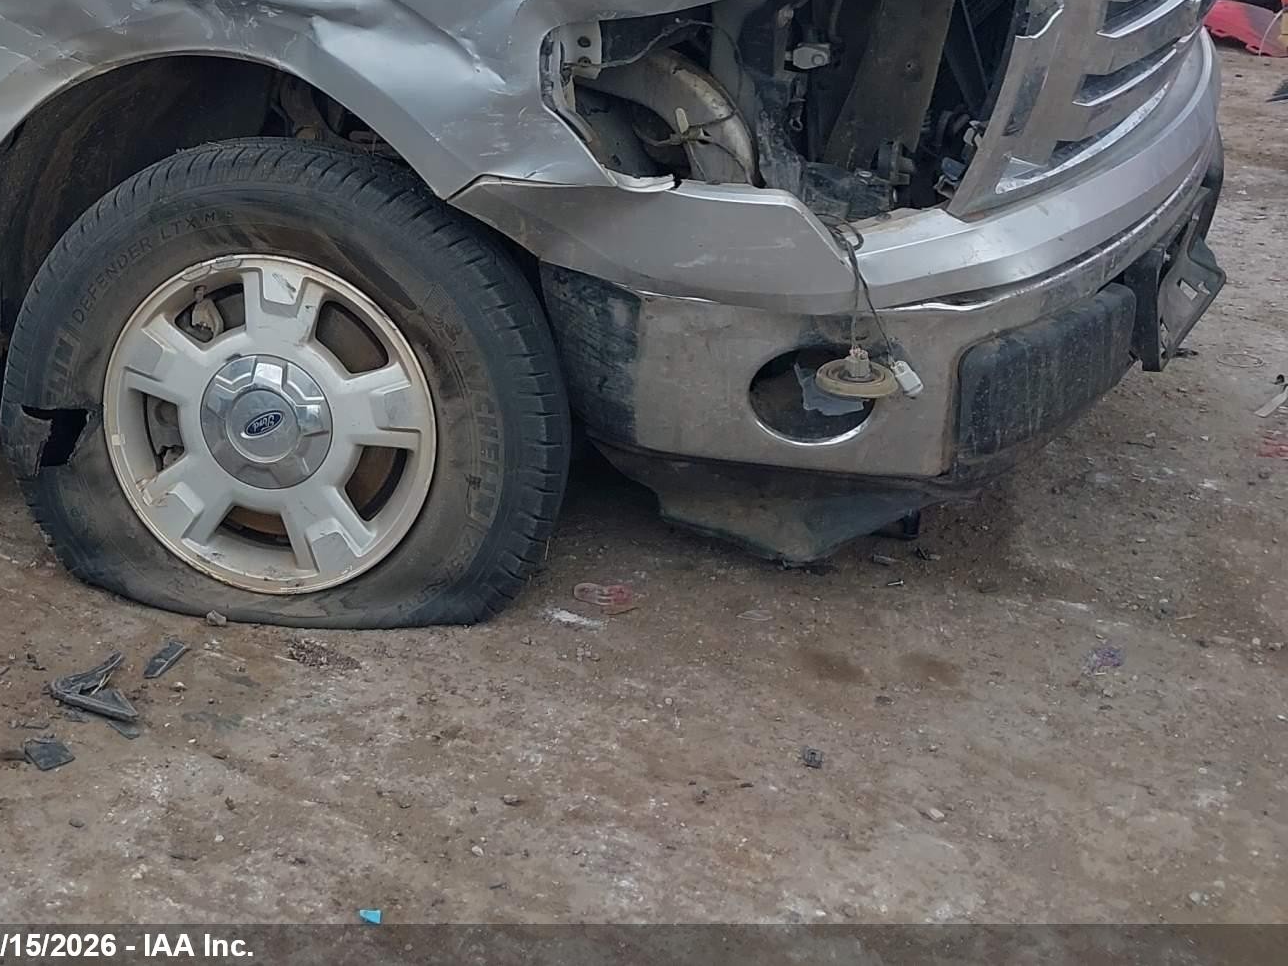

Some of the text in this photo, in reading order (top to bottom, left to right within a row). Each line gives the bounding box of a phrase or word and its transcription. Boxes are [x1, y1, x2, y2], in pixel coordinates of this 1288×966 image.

[72, 236, 153, 324] DEFENDER
[160, 216, 198, 240] LTX
[251, 414, 275, 432] Ford
